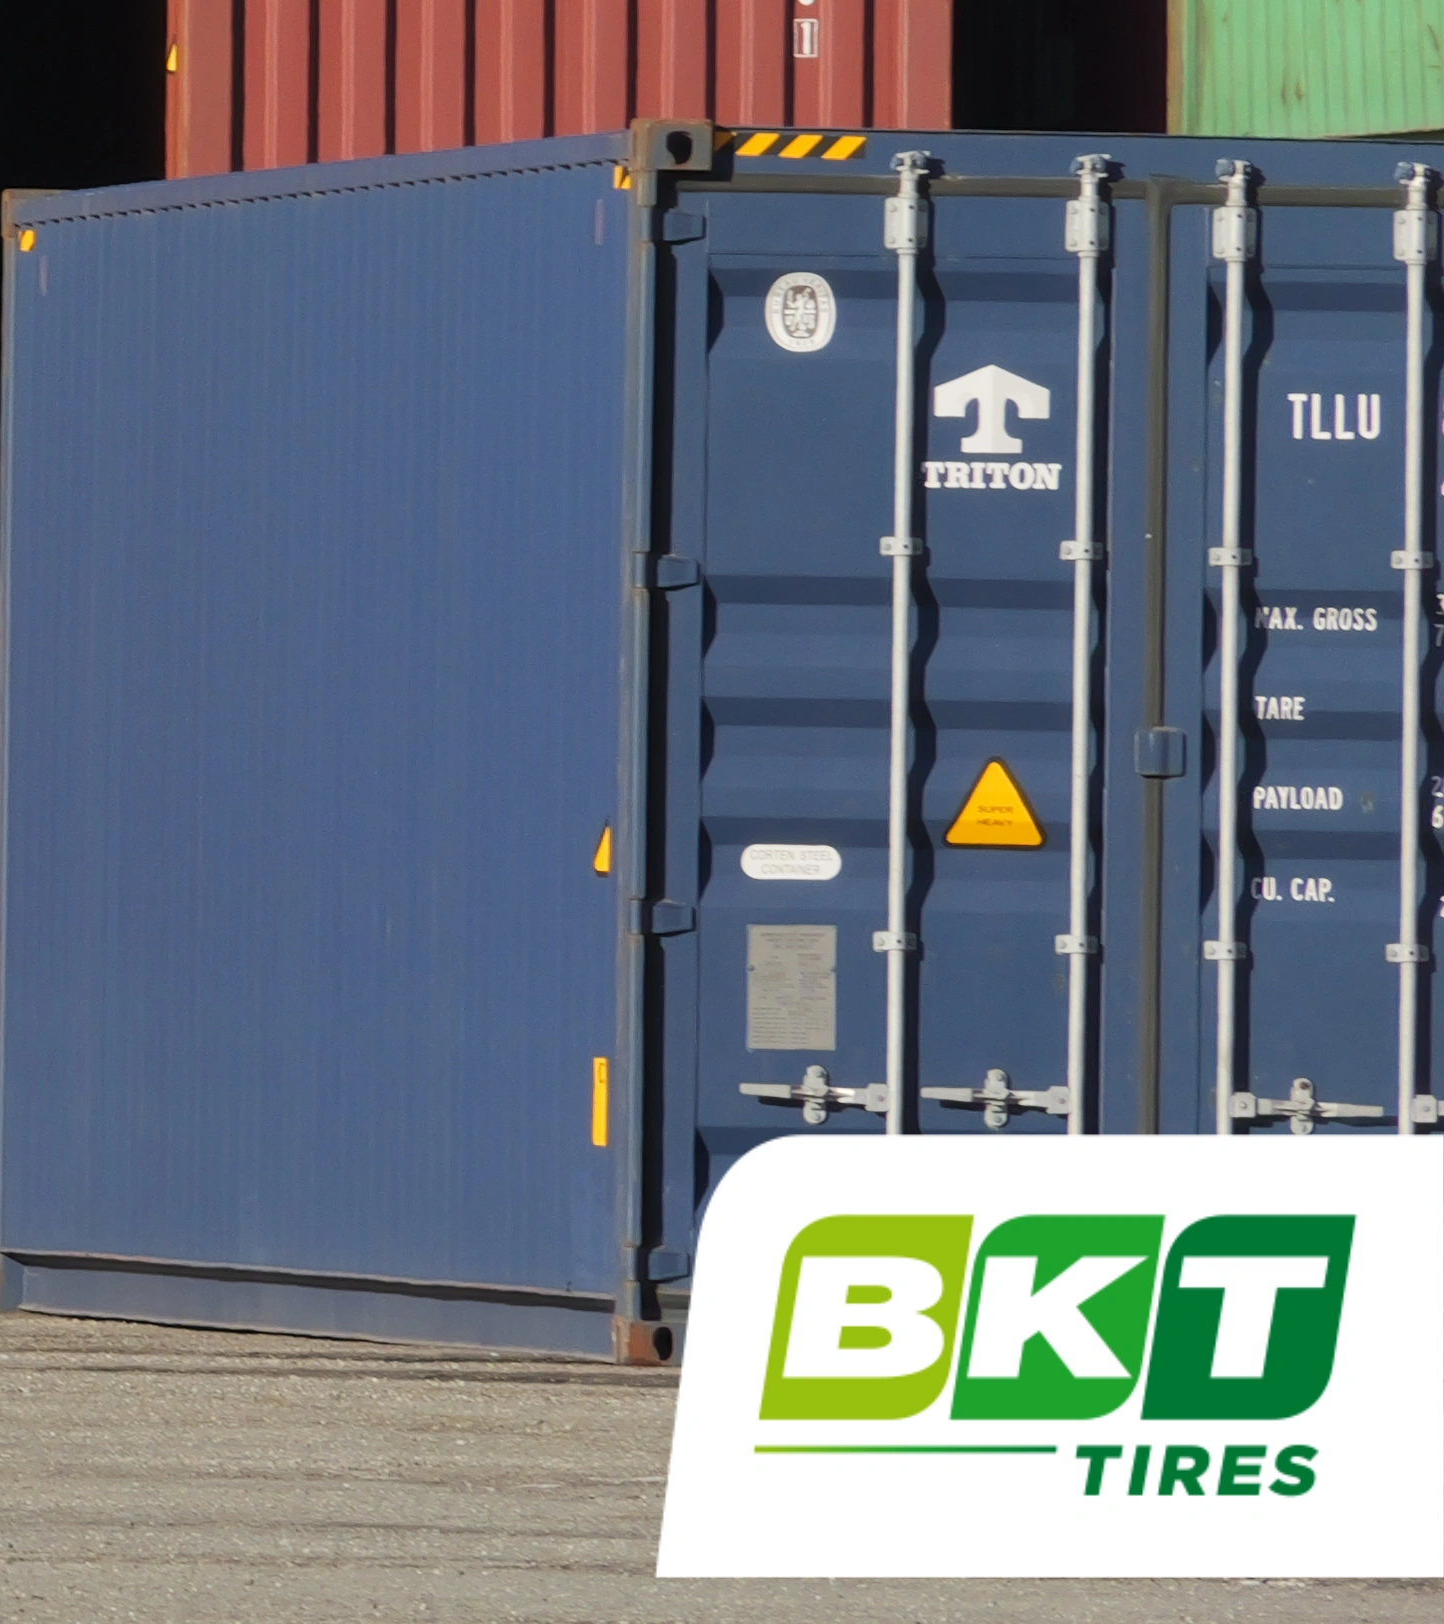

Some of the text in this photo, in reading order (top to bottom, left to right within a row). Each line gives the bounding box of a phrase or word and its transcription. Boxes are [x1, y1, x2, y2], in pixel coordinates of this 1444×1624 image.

[1287, 393, 1380, 440] TLLU
[921, 461, 1062, 491] TRITON
[1254, 607, 1378, 631] MAX. GROSS
[1255, 696, 1306, 721] TARE
[977, 805, 1014, 813] SUPER
[1252, 786, 1344, 810] PAYLOAD
[976, 818, 1013, 826] HEAVY
[749, 850, 834, 862] CORTEN STEEL
[761, 864, 820, 875] CONTAINER
[1290, 878, 1335, 902] CAP.
